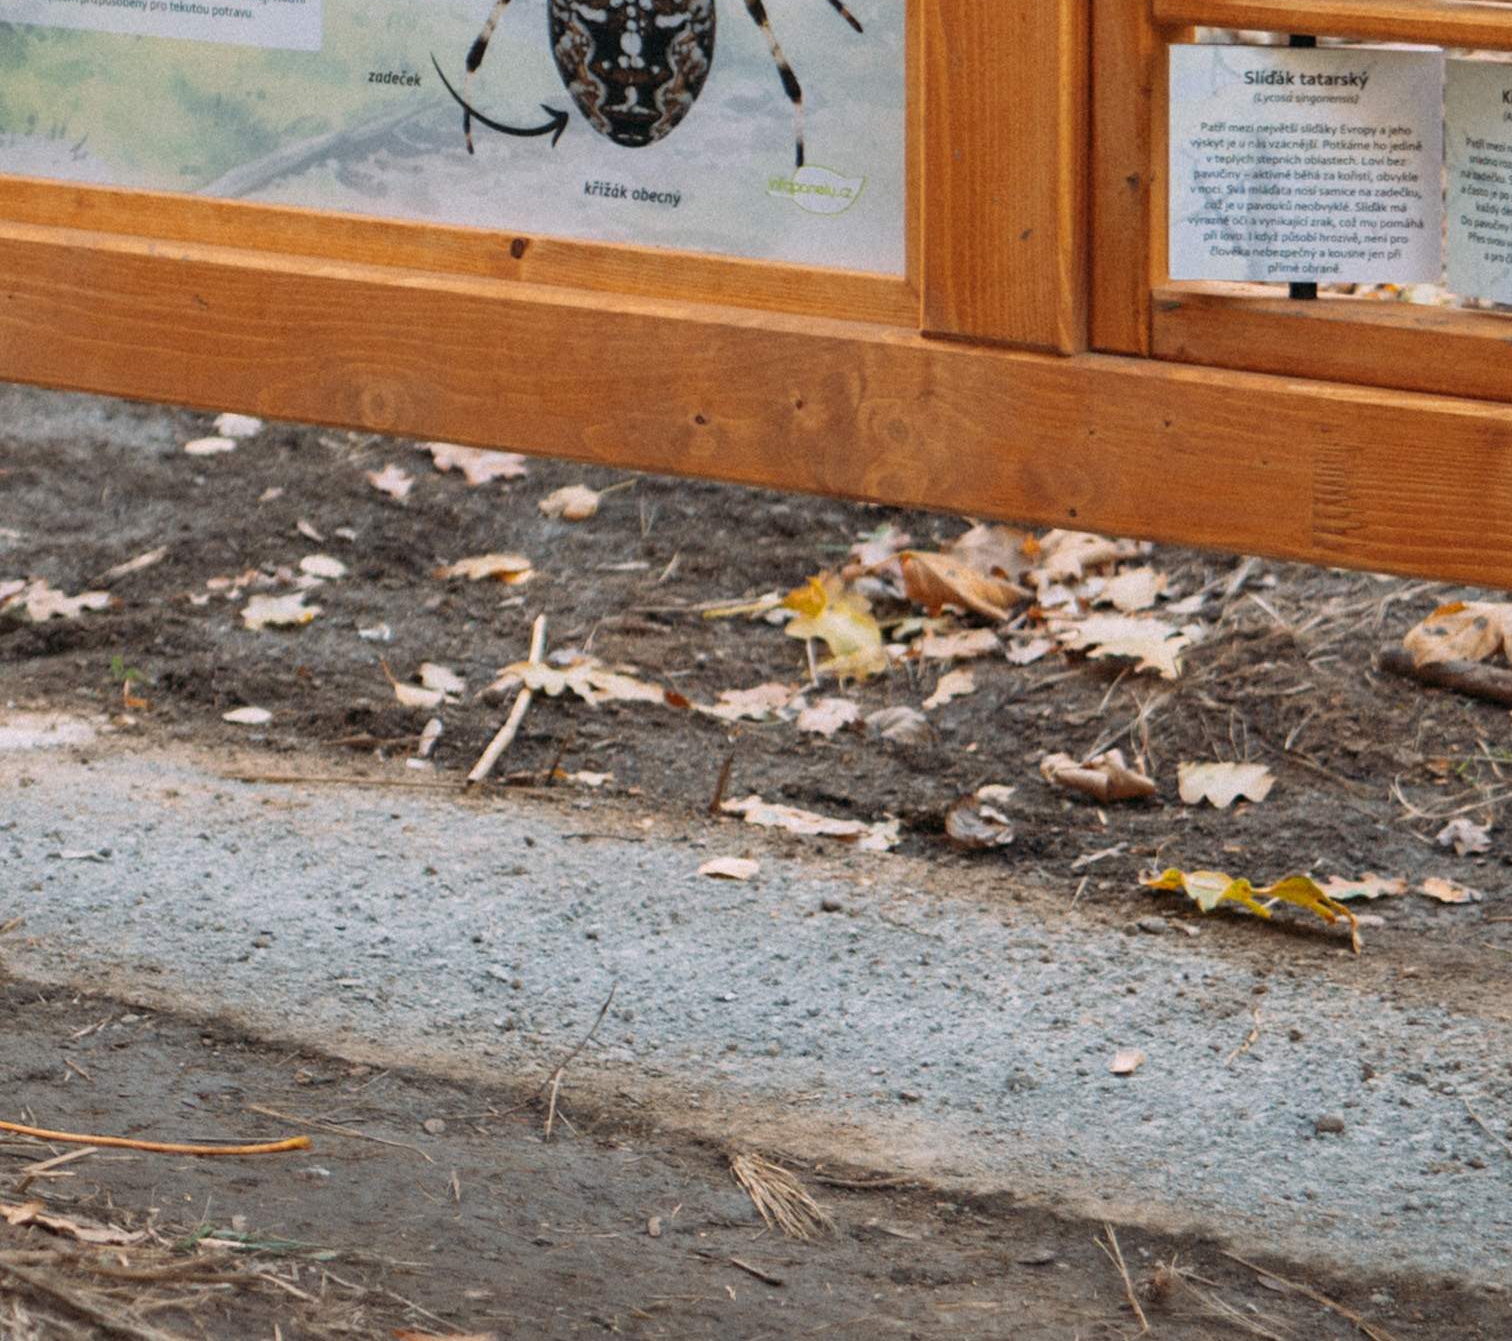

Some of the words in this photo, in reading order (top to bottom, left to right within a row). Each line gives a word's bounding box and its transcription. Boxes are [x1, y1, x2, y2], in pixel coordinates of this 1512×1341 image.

[368, 70, 421, 87] zadeček
[1244, 70, 1295, 86] Slíďák
[1299, 71, 1369, 90] tatarský
[584, 181, 627, 199] křižák
[631, 188, 681, 208] obecný
